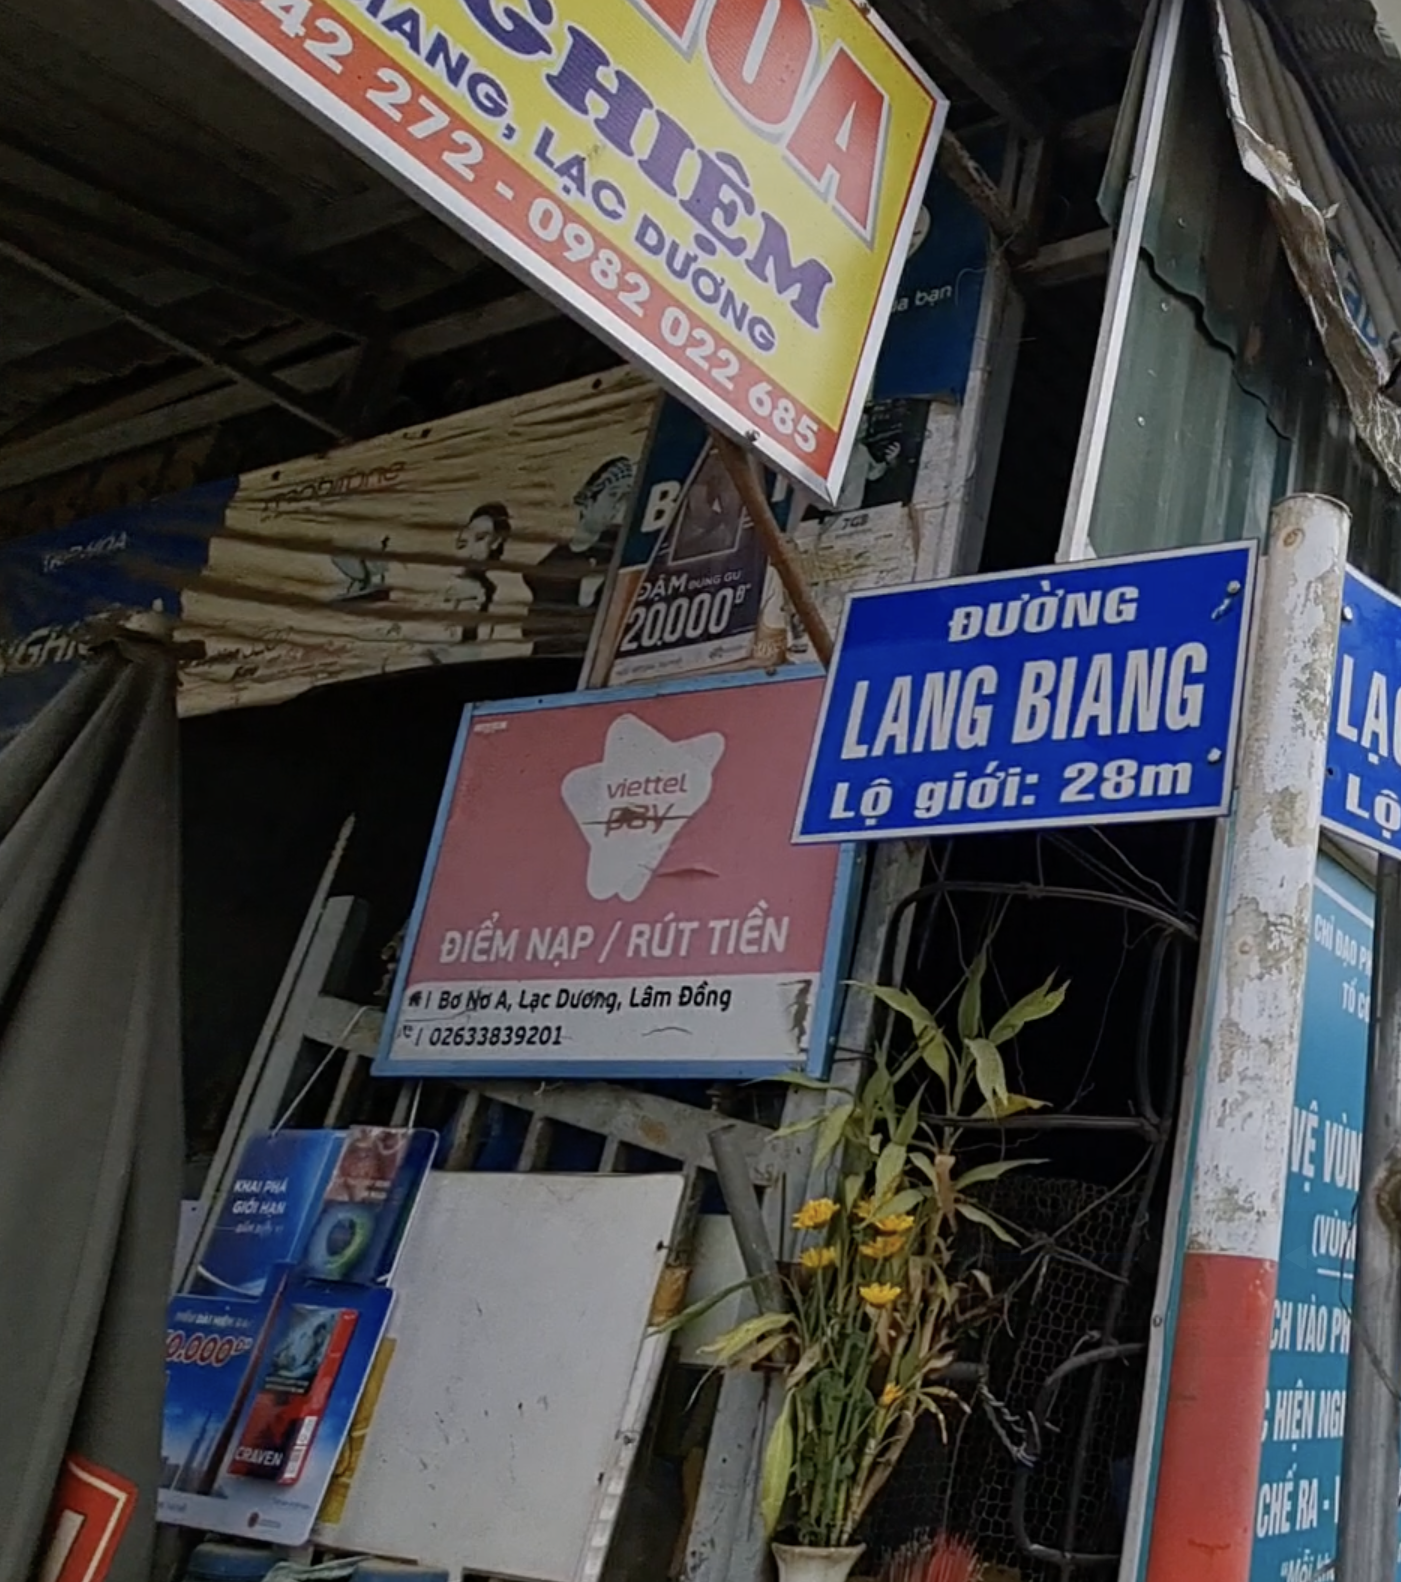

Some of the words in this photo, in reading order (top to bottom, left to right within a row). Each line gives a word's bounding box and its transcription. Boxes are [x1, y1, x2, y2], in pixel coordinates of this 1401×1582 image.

[366, 0, 516, 140] ANG,
[533, 126, 627, 220] LẠC
[635, 214, 775, 351] DƯƠNG
[365, 67, 484, 182] 272
[528, 197, 651, 318] 0982
[660, 306, 740, 391] 022
[748, 382, 819, 453] 685
[948, 581, 1139, 642] ĐƯỜNG
[841, 665, 998, 760] LANG
[1011, 641, 1208, 745] BIANG
[607, 773, 688, 799] viettel
[829, 777, 893, 826] Lộ
[914, 760, 1040, 820] giới:
[1060, 759, 1193, 803] 28m
[439, 911, 520, 963] ĐIỂM
[525, 925, 595, 968] NẠP
[626, 911, 699, 958] RÚT
[708, 899, 790, 955] TIỀN
[1314, 913, 1335, 951] CHỈ
[518, 989, 552, 1013] Lạc
[629, 985, 672, 1008] Lâm
[678, 980, 732, 1012] Đồng
[429, 1025, 563, 1046] 02633839201
[1323, 1112, 1362, 1193] VÙN
[1296, 1294, 1328, 1352] VÀO
[1273, 1378, 1315, 1452] HIỆN
[235, 1446, 283, 1467] CRAVEN
[1256, 1463, 1297, 1538] CHẾ
[1295, 1478, 1319, 1531] RA
